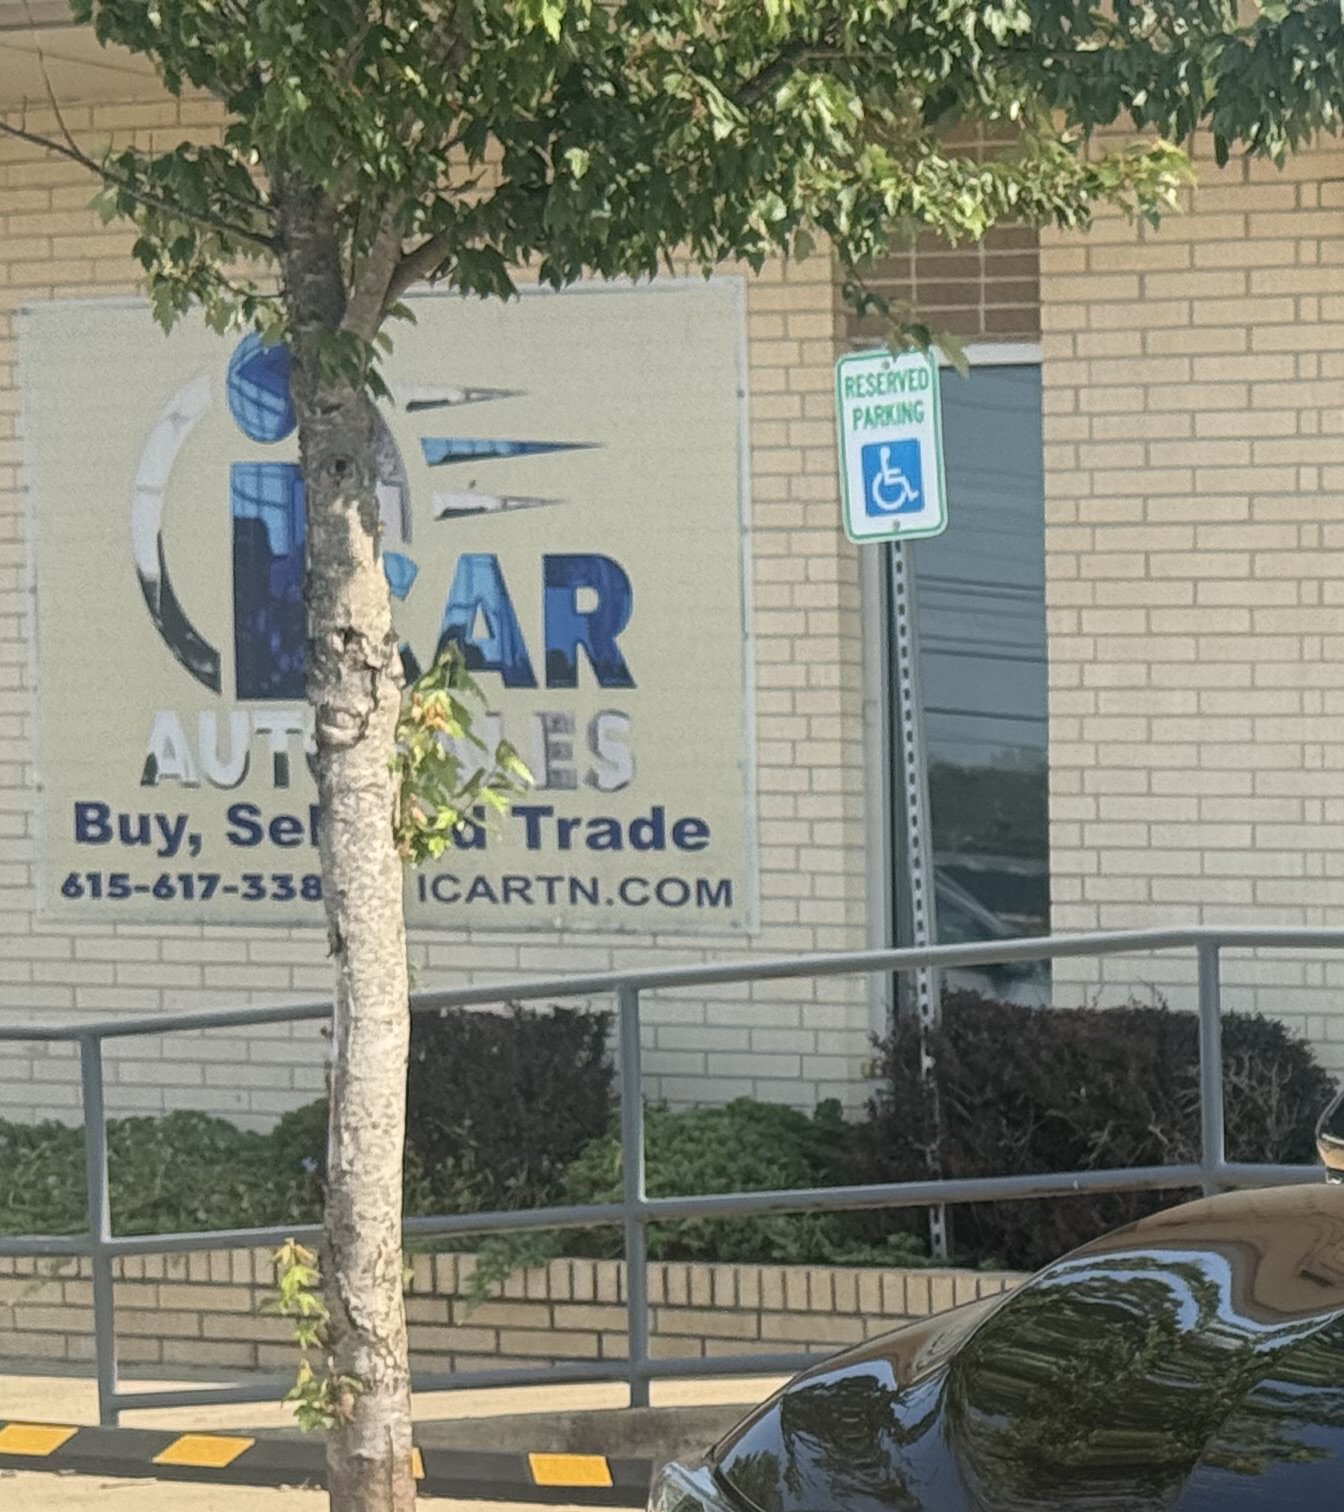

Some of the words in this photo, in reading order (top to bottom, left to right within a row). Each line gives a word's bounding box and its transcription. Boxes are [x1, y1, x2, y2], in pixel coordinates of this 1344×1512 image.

[844, 367, 929, 399] RESERVED
[852, 399, 925, 430] PARKING
[140, 708, 635, 792] AUTLES
[74, 801, 203, 858] Buy,
[226, 803, 321, 848] Sel
[511, 805, 711, 852] Trade
[61, 872, 323, 900] 615-617-338
[417, 873, 733, 908] ICARTN.COM
